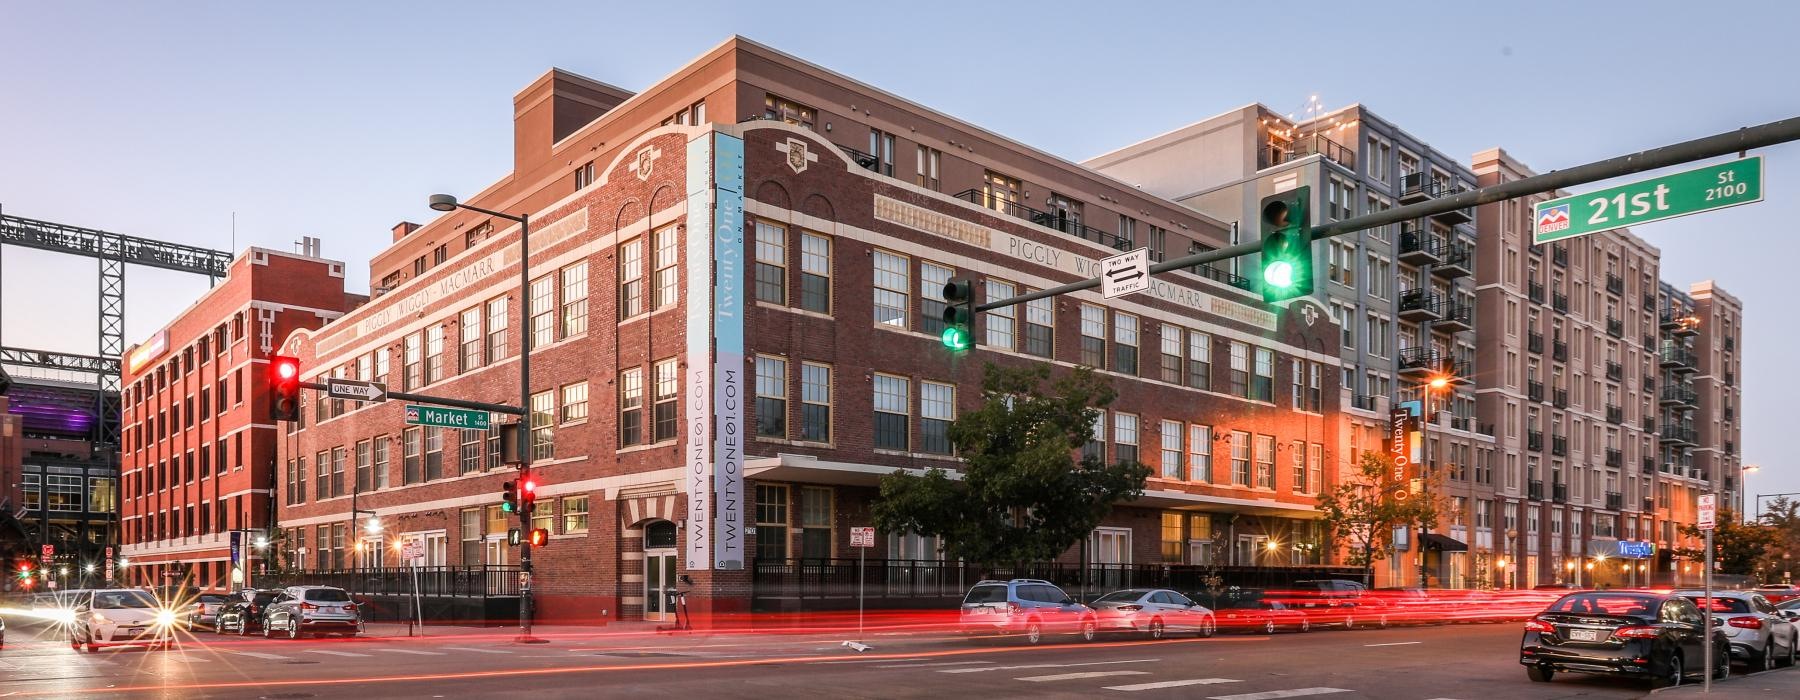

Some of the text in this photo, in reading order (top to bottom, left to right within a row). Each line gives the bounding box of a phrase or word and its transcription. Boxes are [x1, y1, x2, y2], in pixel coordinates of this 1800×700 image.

[1717, 169, 1735, 185] St
[1705, 182, 1747, 201] 2100
[1587, 183, 1670, 225] 21st
[737, 226, 743, 244] ON
[1540, 220, 1568, 234] DENVER
[718, 199, 738, 321] TwentyOne
[1010, 237, 1061, 268] PIGGLY
[1108, 253, 1139, 267] TWO WAY
[365, 308, 392, 331] PIGGLY
[397, 288, 431, 316] WIGGLY
[440, 257, 495, 297] MACMARR
[1112, 281, 1139, 293] TRAFFIC
[334, 385, 369, 396] ONE WAY
[425, 410, 468, 426] Market
[1391, 409, 1408, 481] TwentyOne
